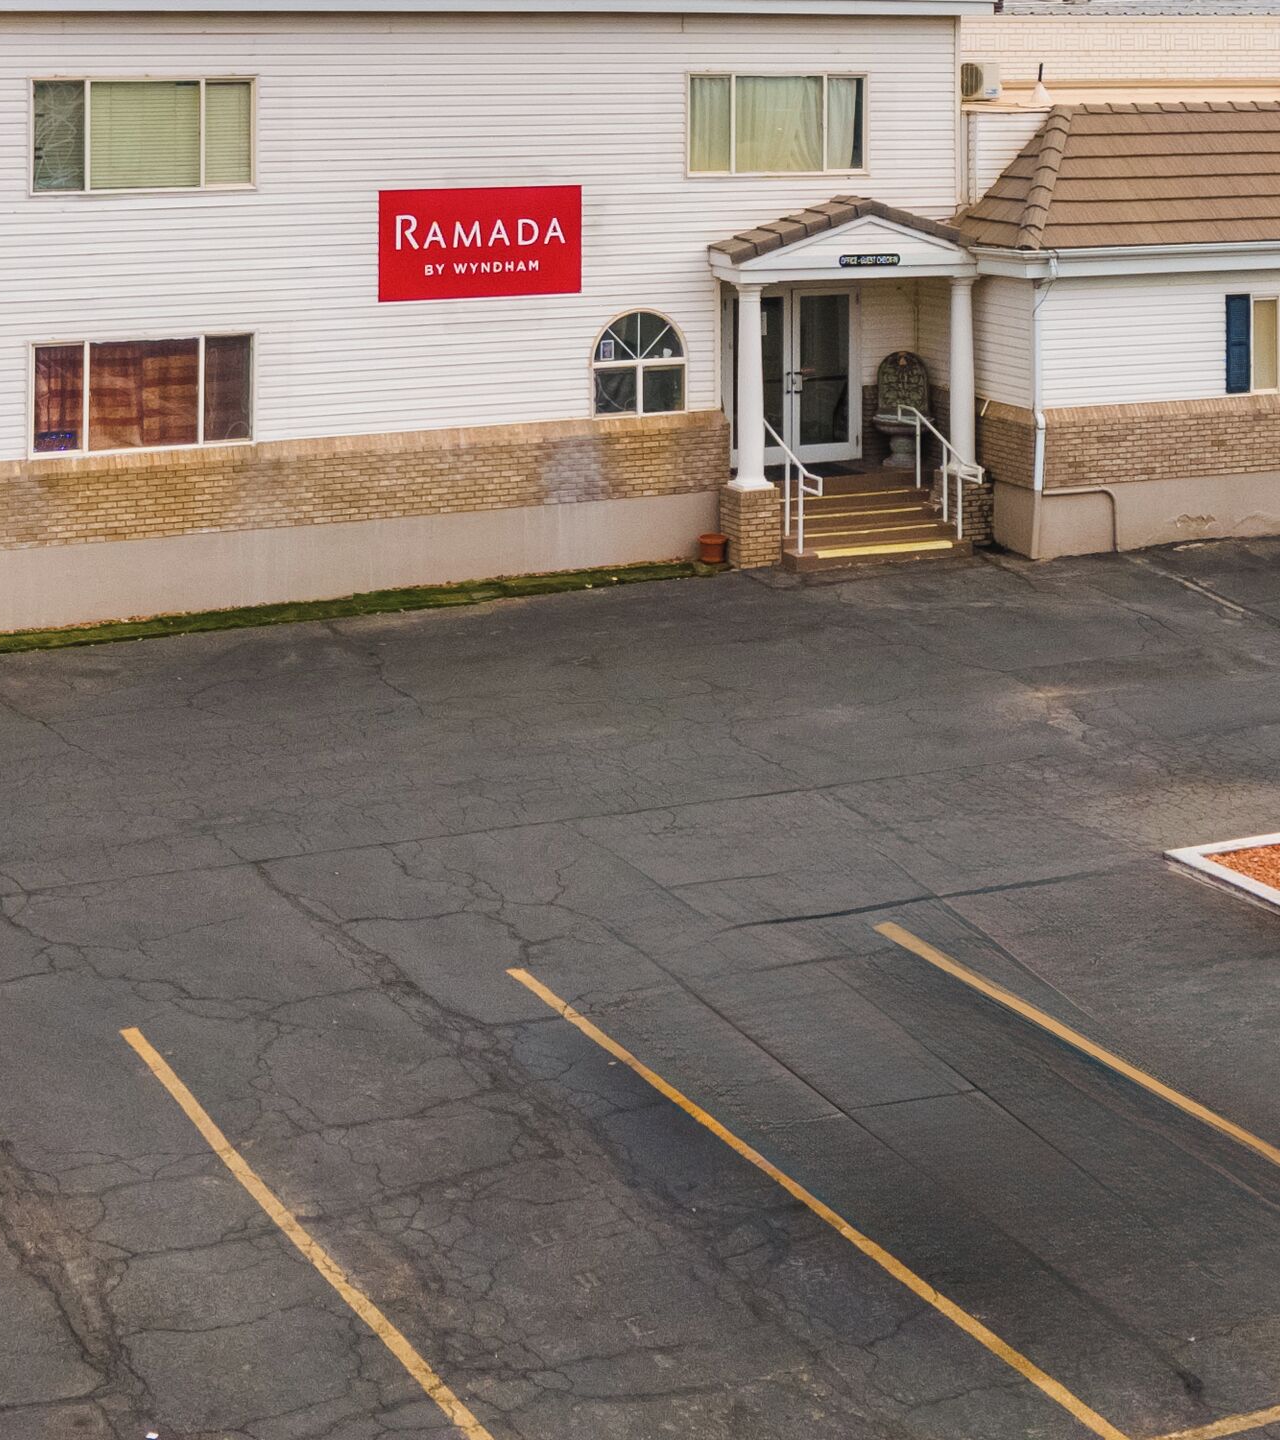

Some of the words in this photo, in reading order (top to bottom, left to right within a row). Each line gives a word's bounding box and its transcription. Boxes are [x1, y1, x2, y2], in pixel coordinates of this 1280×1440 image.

[396, 215, 566, 250] RAMADA
[424, 264, 445, 276] BY
[454, 260, 539, 274] WYNDHAM
